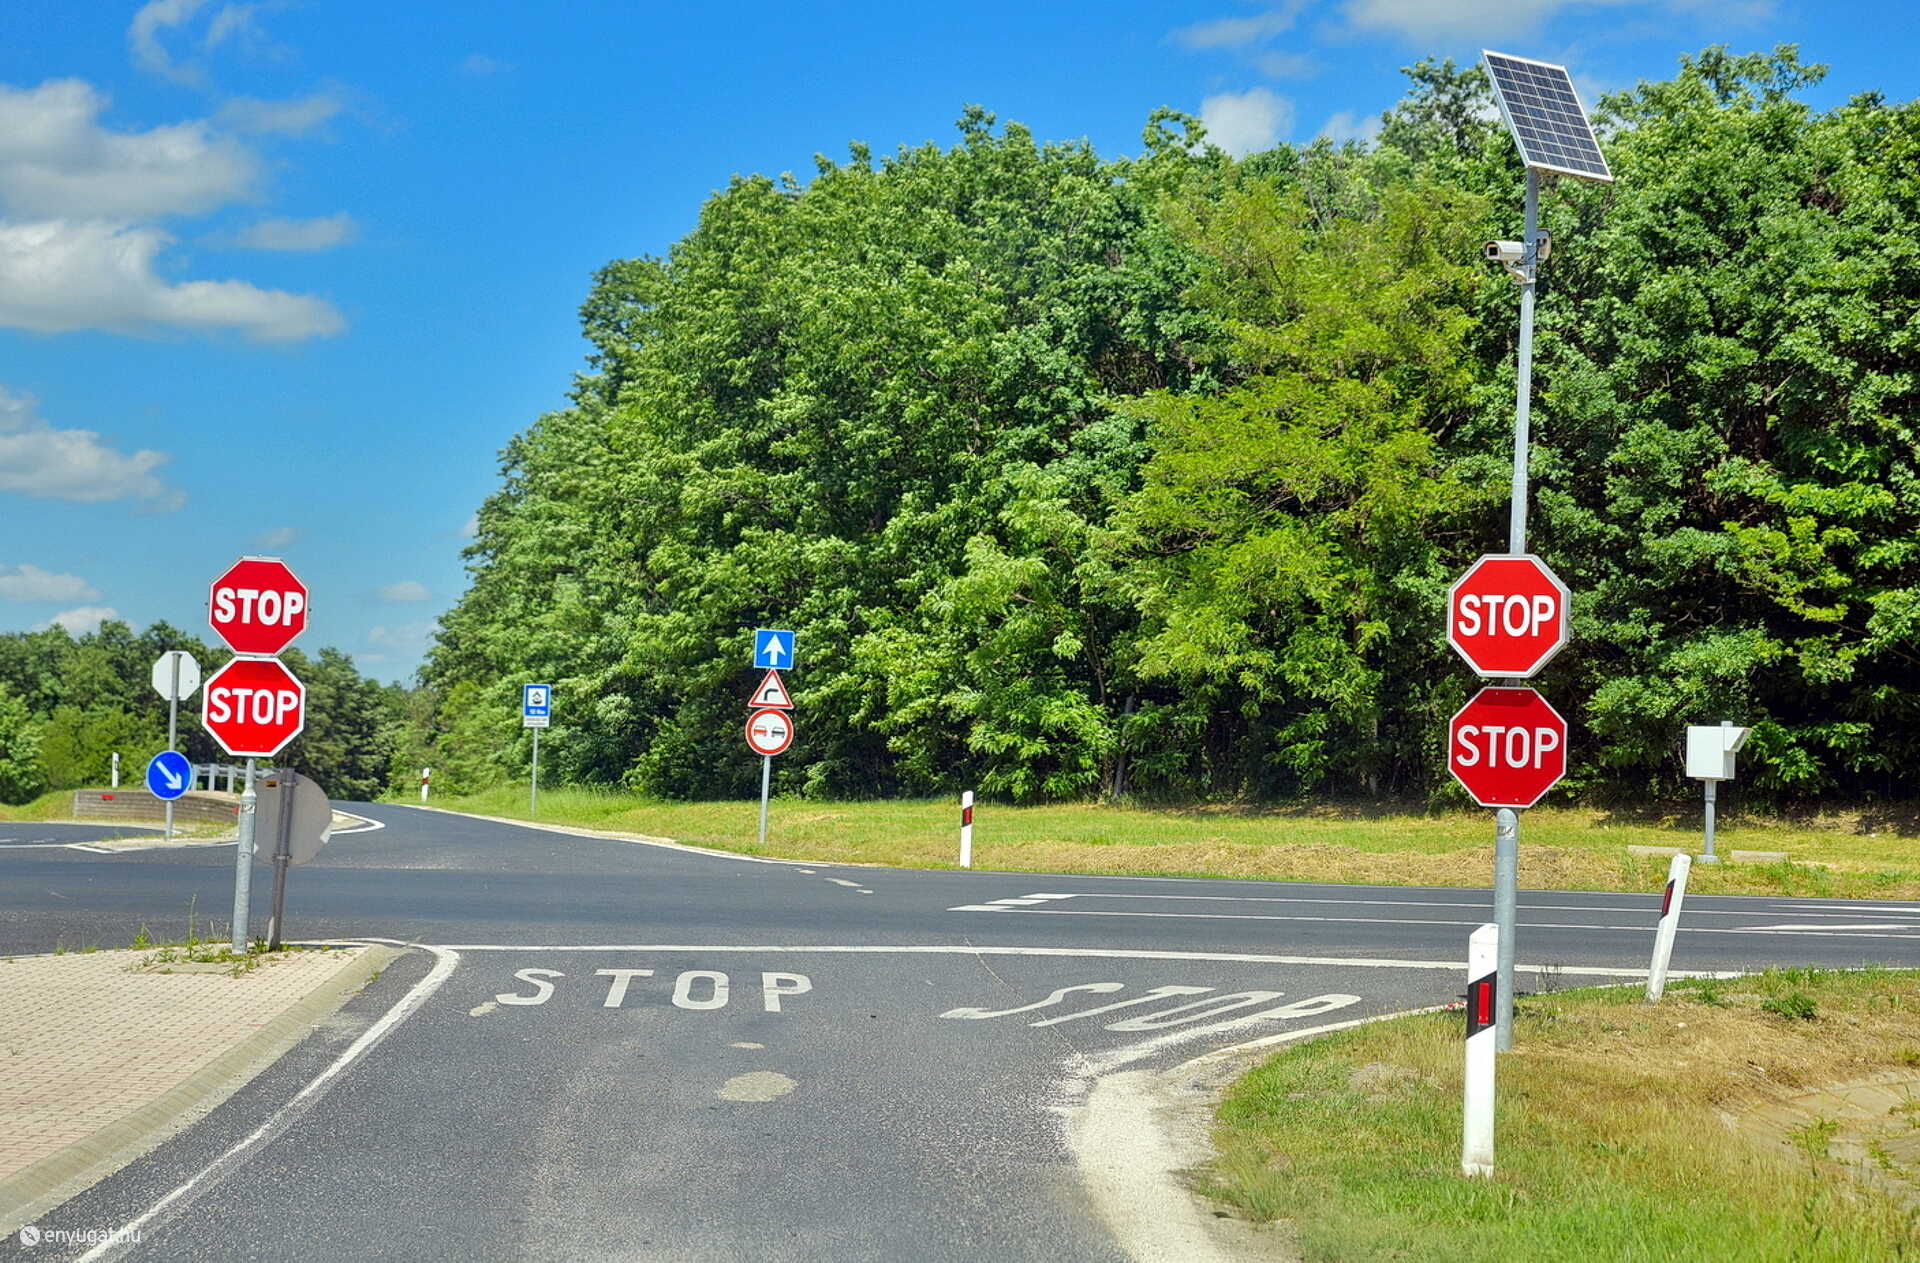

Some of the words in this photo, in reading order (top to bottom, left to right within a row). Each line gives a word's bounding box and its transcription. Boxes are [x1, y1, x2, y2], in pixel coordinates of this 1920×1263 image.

[214, 587, 304, 626] STOP
[1458, 594, 1555, 637] STOP
[209, 687, 299, 725] STOP
[1456, 724, 1559, 769] STOP
[495, 967, 813, 1012] STOP
[939, 982, 1362, 1042] STOP
